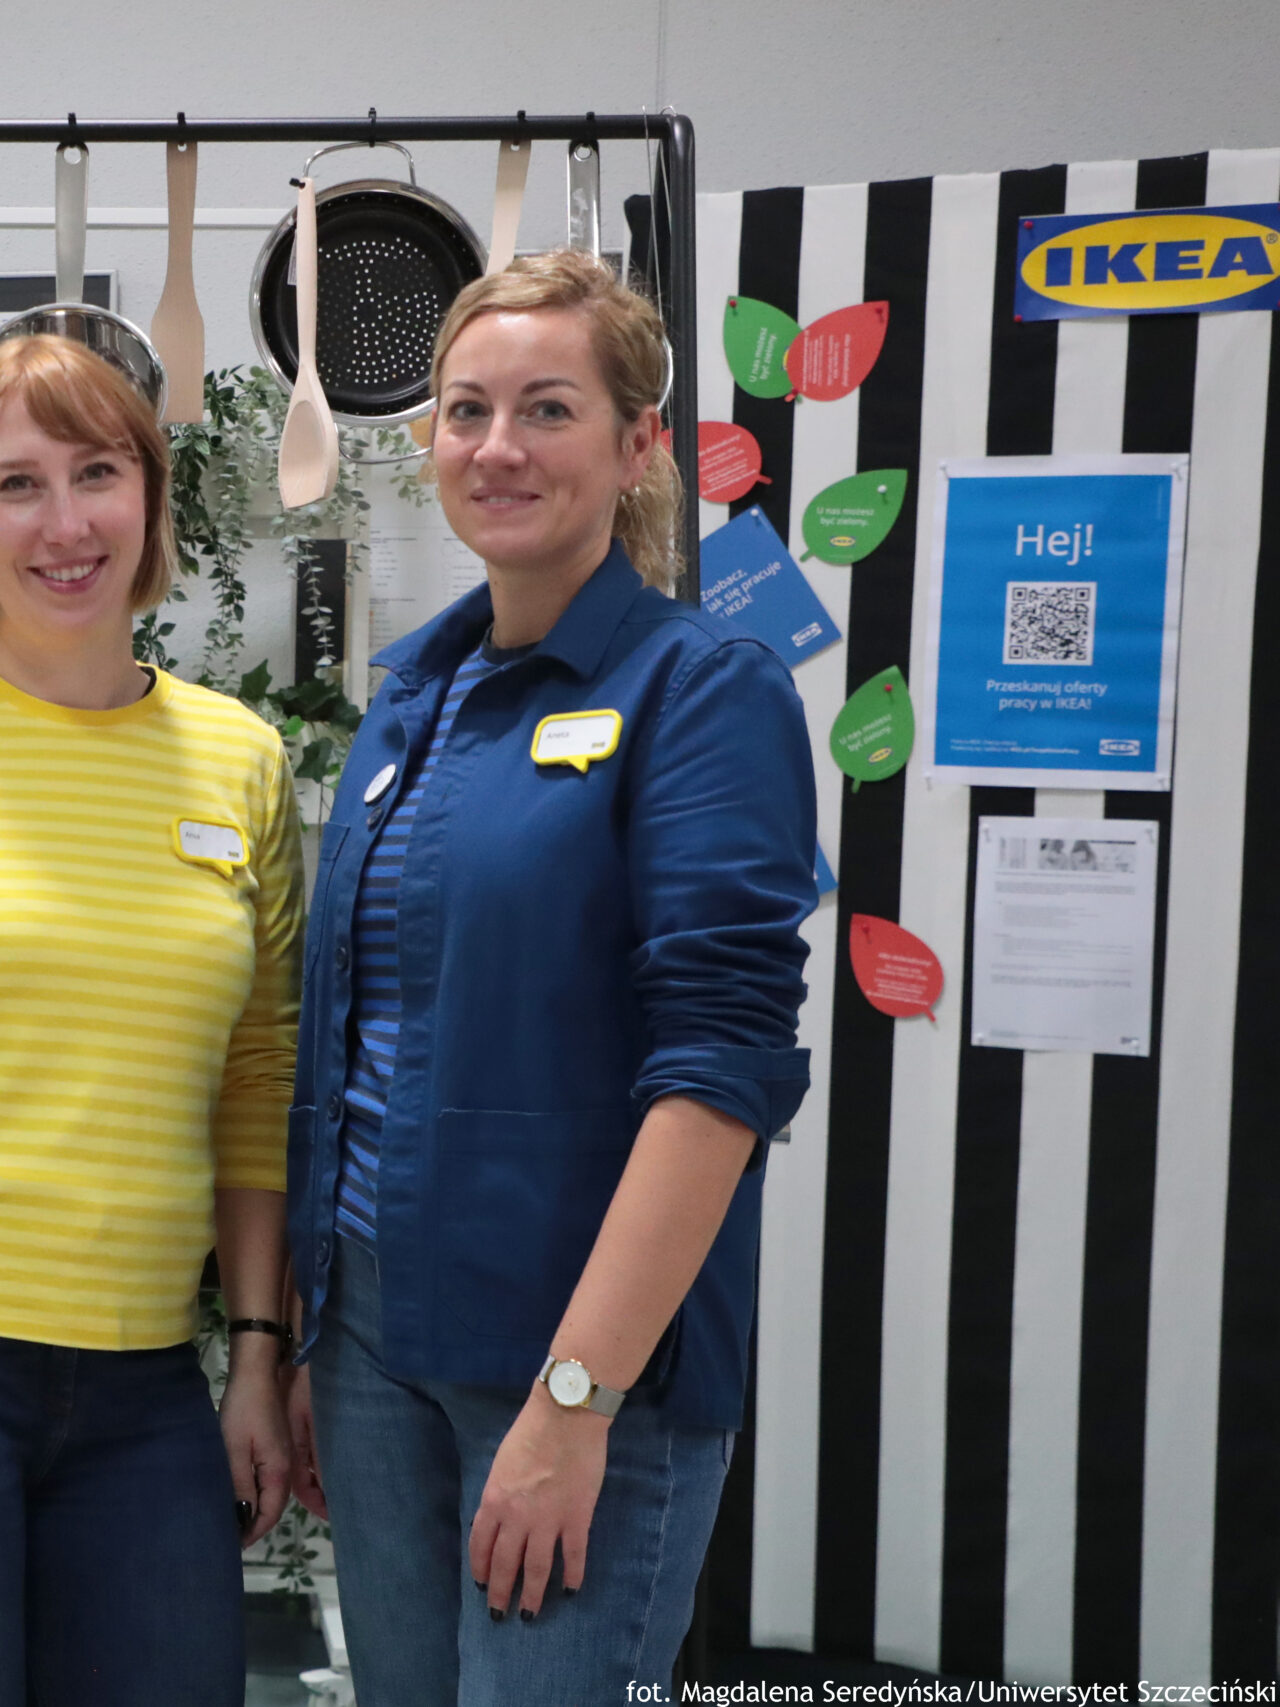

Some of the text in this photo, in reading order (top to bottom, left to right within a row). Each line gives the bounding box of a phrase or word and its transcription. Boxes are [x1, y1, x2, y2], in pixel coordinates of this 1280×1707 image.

[1044, 236, 1276, 288] IKEA
[1015, 523, 1094, 566] Hej!
[740, 561, 782, 593] pracuje
[723, 593, 754, 617] IKEA!
[985, 679, 1108, 697] Przeskanuj oferty
[998, 698, 1092, 712] pracy w IKEA!
